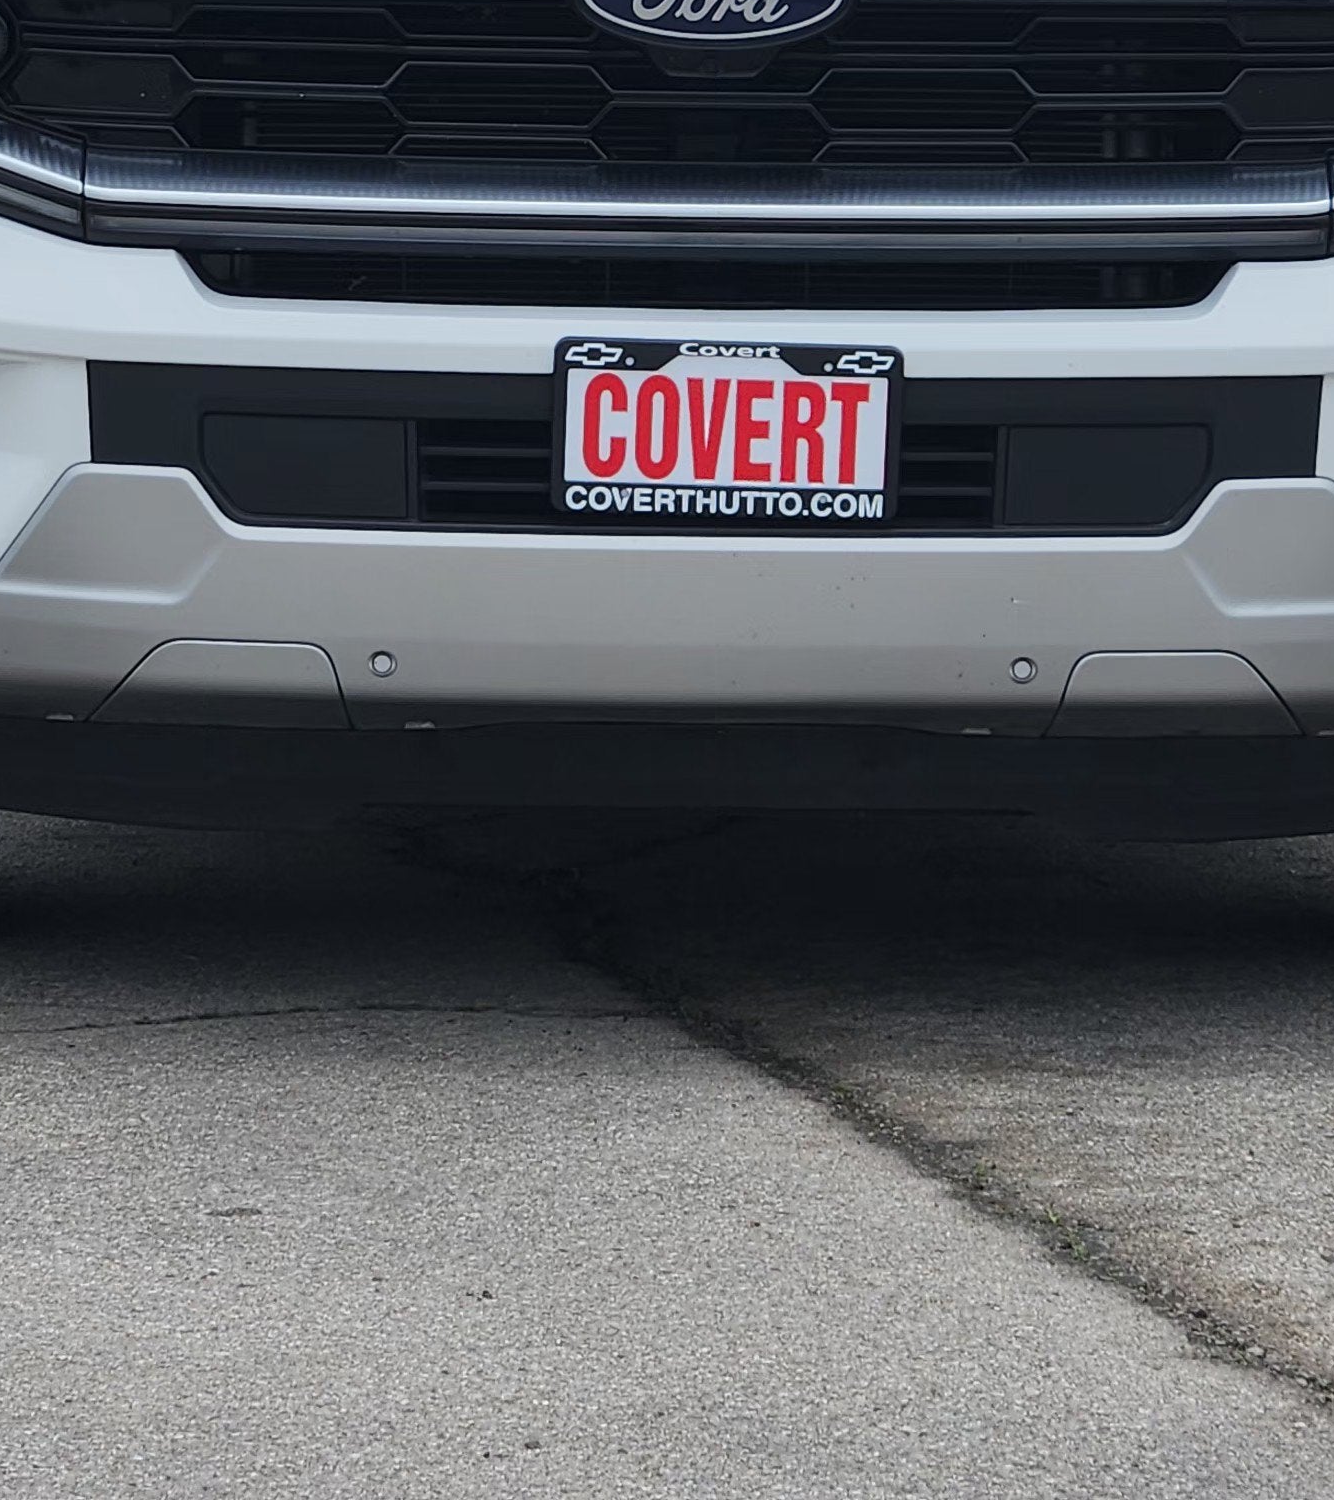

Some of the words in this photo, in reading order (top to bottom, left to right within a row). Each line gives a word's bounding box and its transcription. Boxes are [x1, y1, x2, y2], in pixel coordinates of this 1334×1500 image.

[679, 342, 781, 359] Covert
[582, 372, 871, 485] COVERT
[566, 485, 883, 519] COVERTHUTTO.COM
